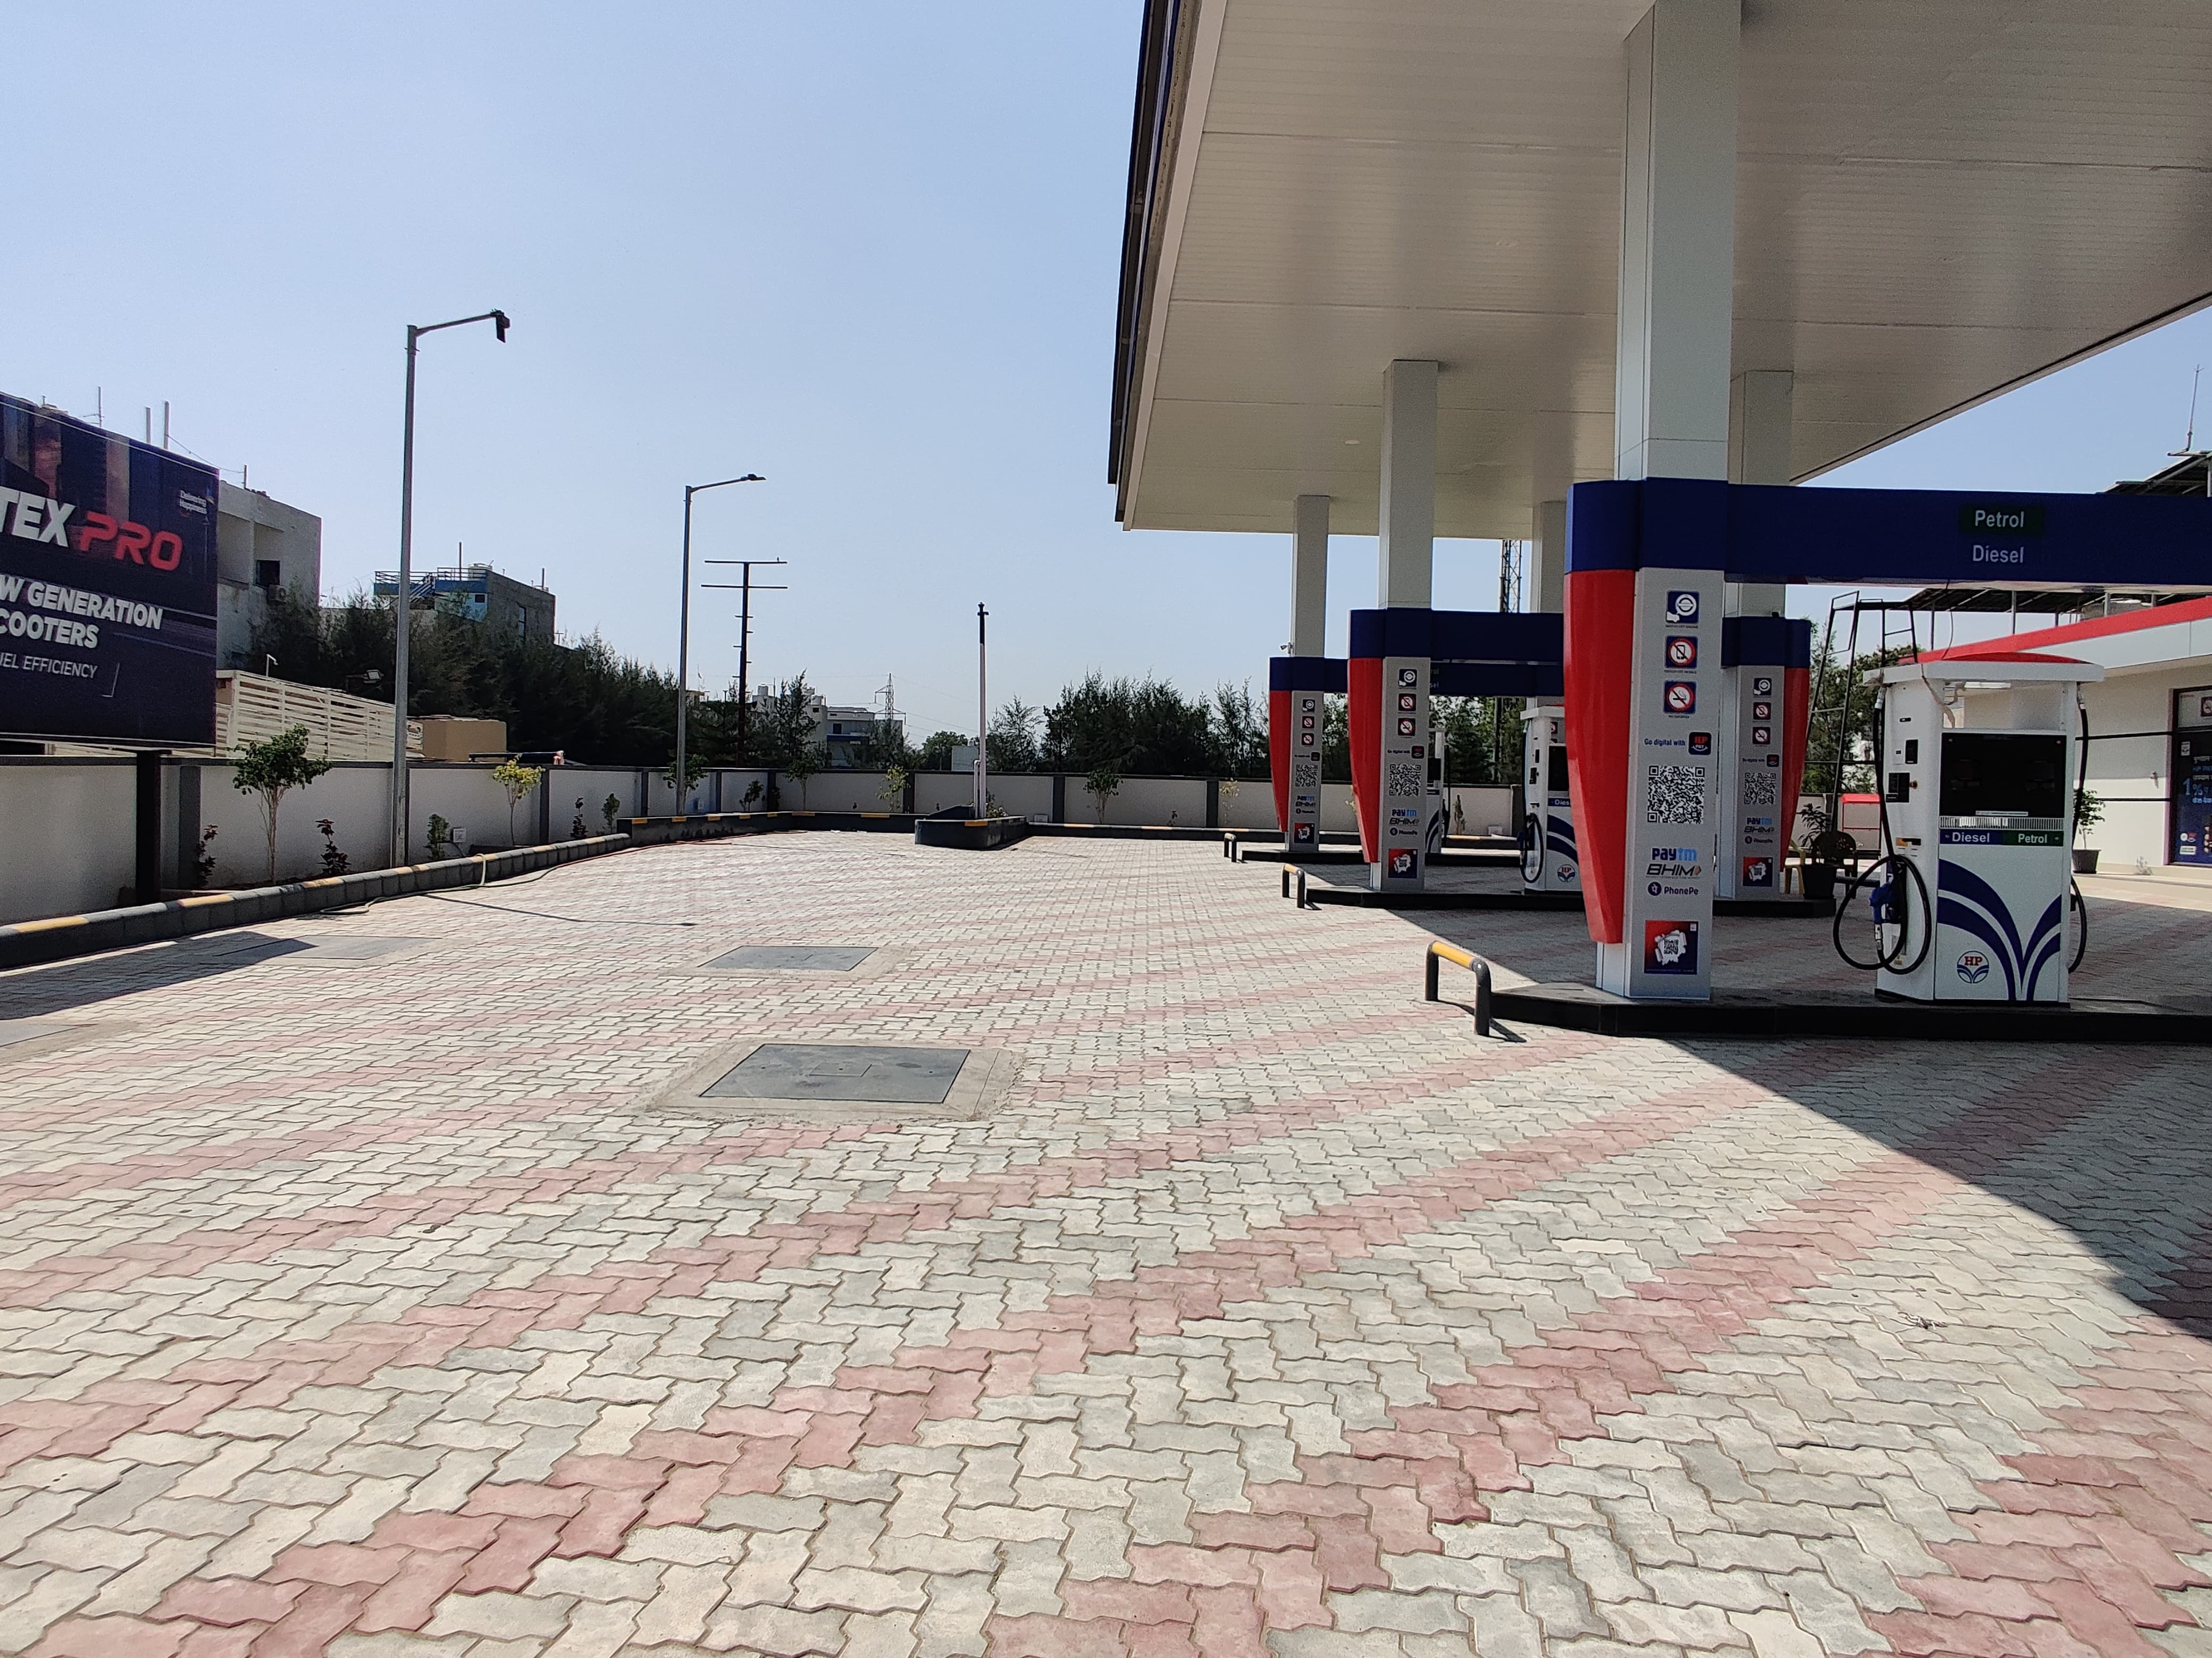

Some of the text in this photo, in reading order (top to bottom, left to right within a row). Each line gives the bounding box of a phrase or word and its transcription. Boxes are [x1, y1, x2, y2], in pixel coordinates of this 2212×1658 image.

[1975, 510, 2025, 527] Petrol
[80, 510, 182, 571] PRO
[1973, 545, 2025, 563] Diesel
[28, 582, 163, 629] GENERATION
[23, 655, 98, 678] EFFICIENCY
[1952, 832, 2048, 844] Diesel Petrol
[1646, 863, 1695, 876] BHIM
[1664, 886, 1699, 895] PhonePe
[1964, 956, 1983, 966] HP
